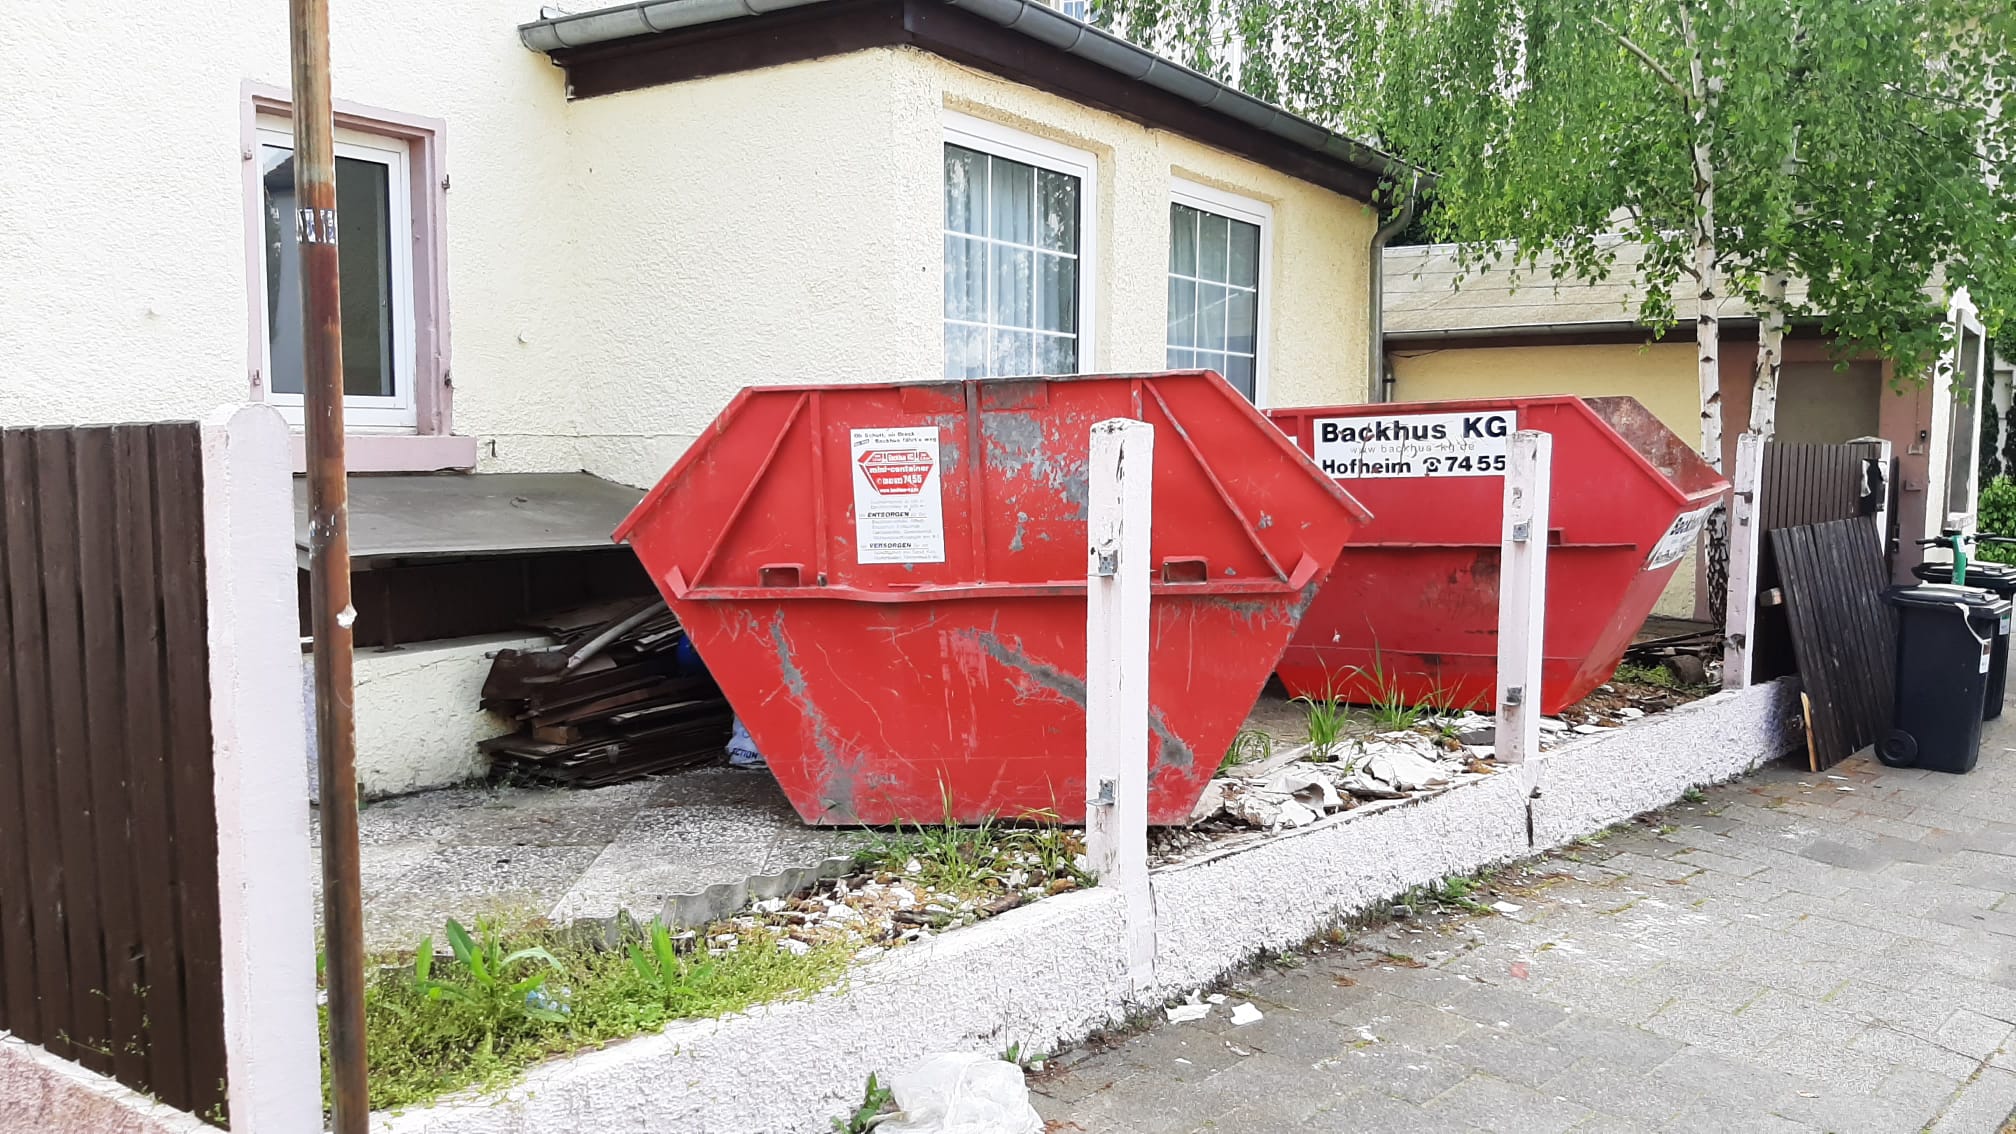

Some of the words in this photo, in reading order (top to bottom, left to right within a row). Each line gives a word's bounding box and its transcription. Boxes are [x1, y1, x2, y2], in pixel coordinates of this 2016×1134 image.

[1321, 420, 1446, 442] Backhus
[1463, 416, 1507, 438] KG
[1322, 458, 1411, 474] Hofheim
